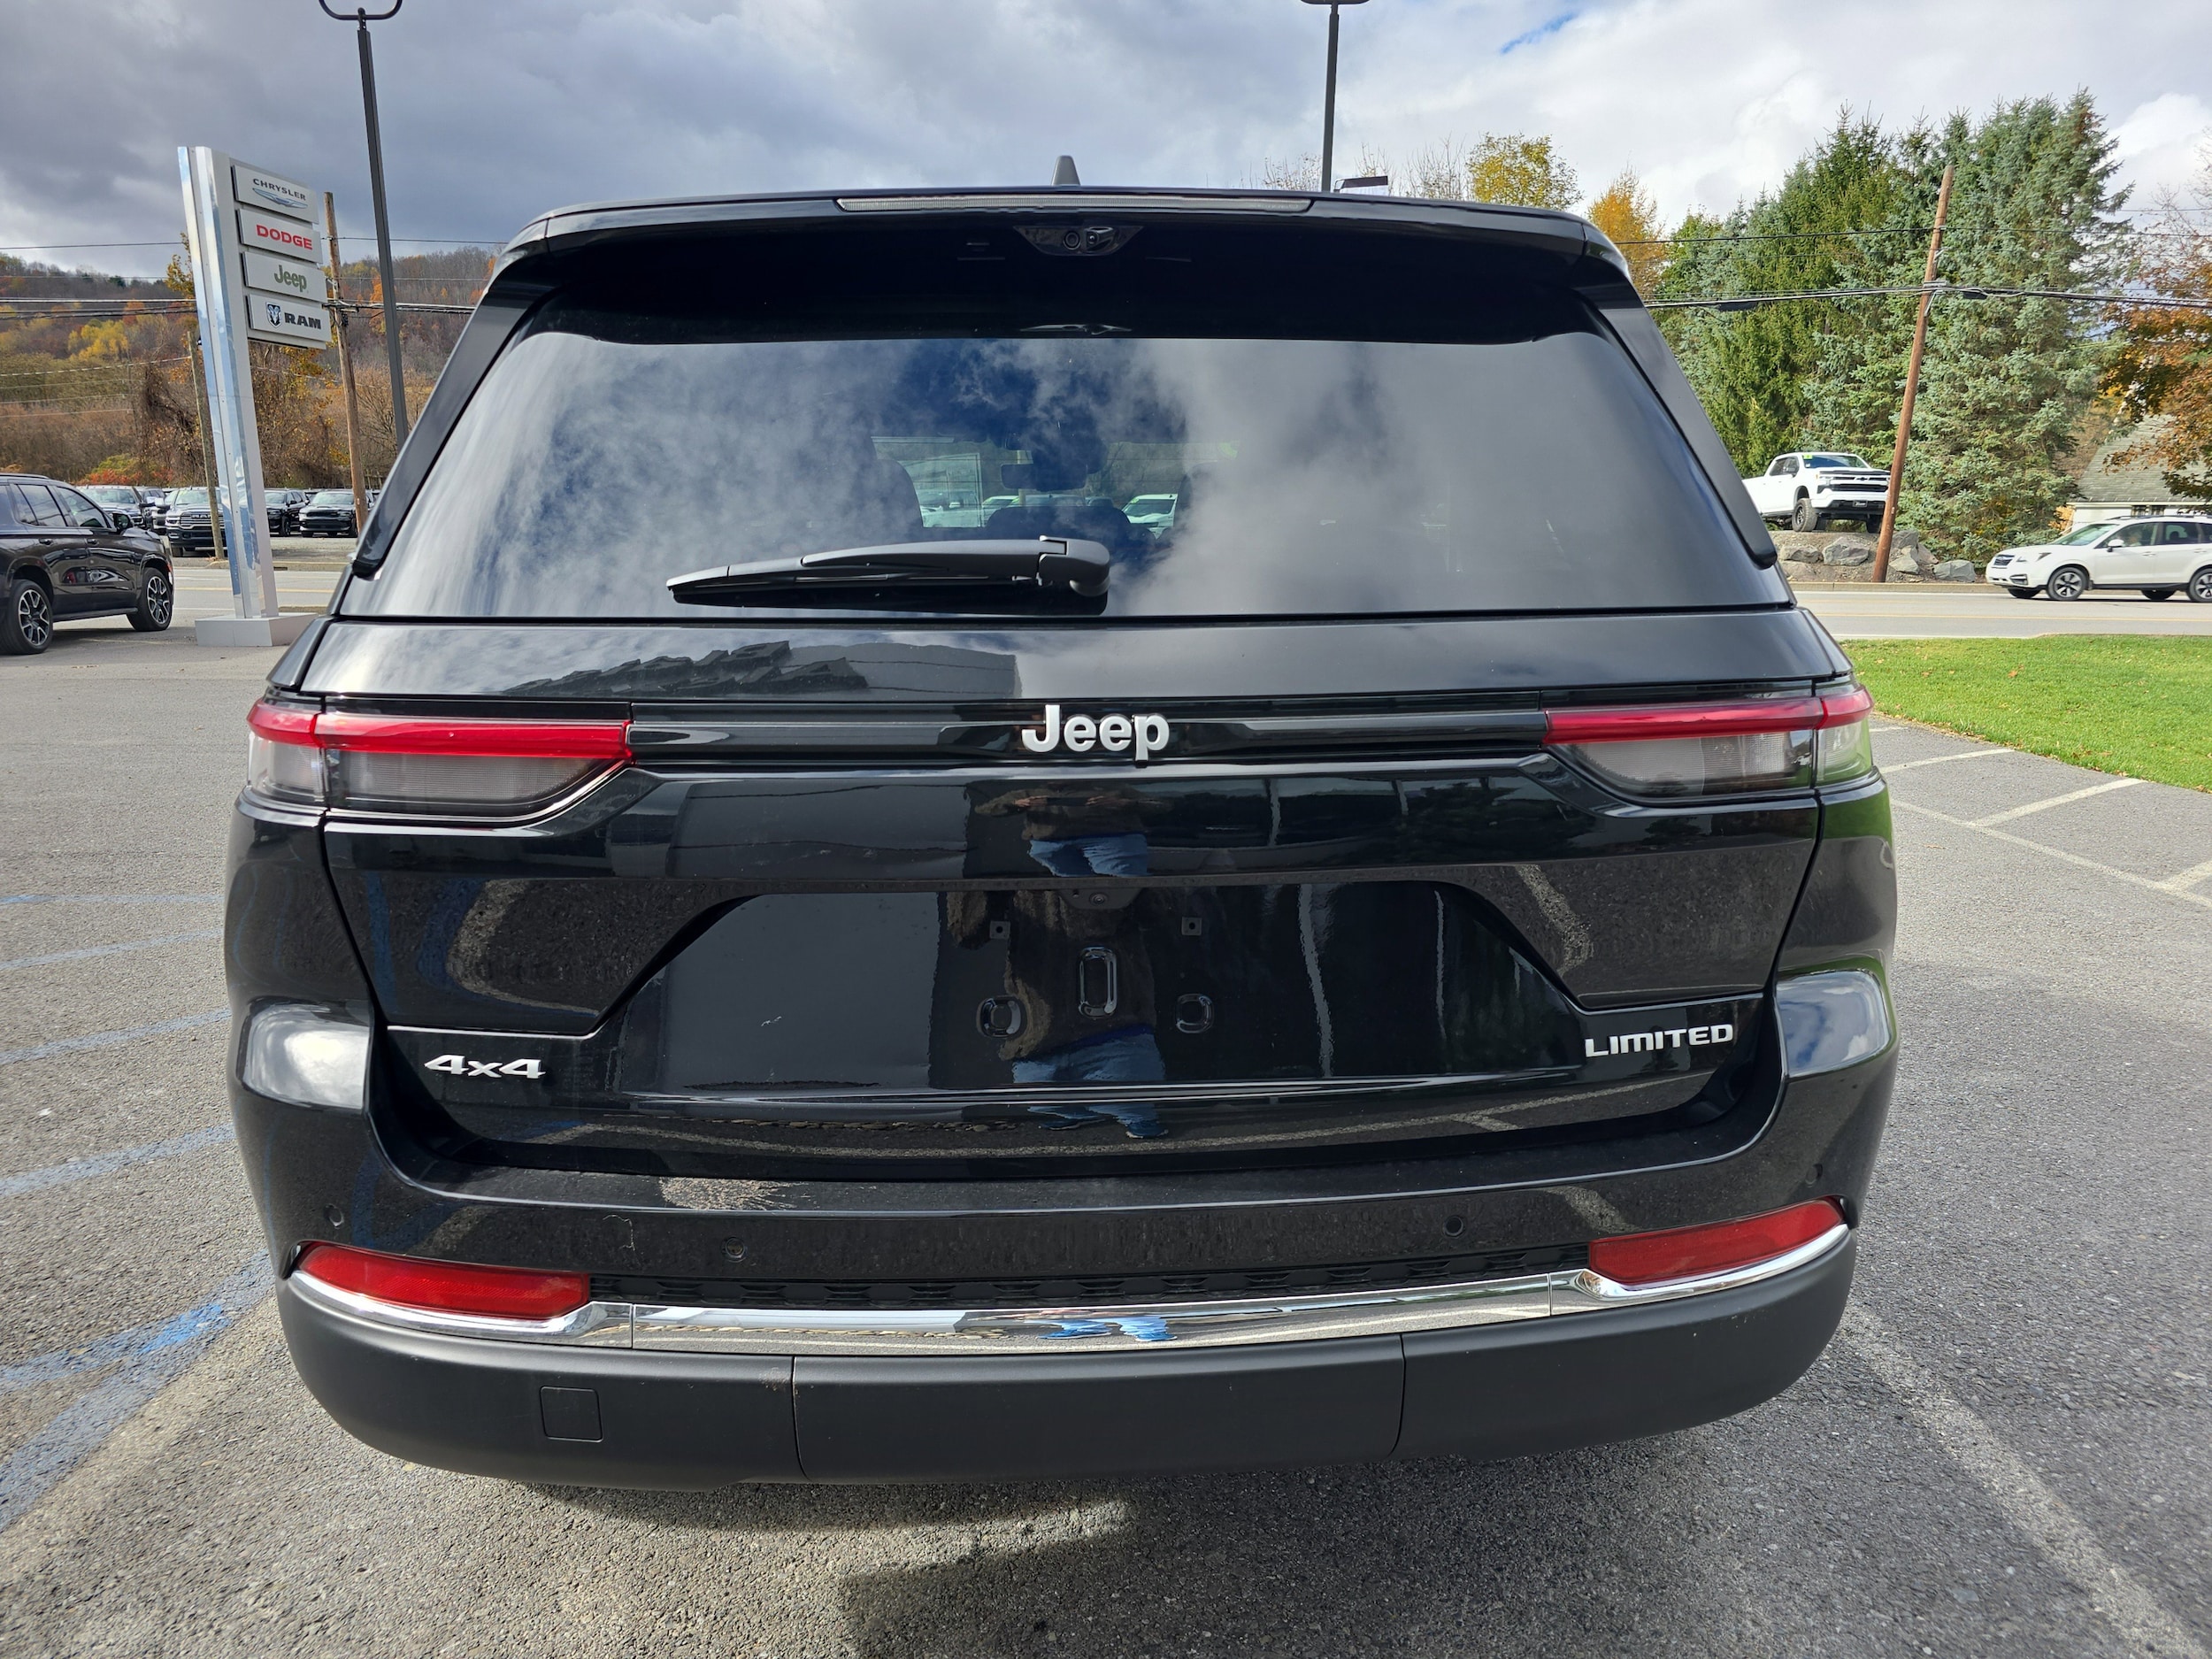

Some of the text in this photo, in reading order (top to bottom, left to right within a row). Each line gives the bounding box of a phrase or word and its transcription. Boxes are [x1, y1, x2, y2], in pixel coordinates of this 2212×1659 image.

[252, 178, 307, 201] CHRYSLER
[256, 224, 313, 250] DODGE
[273, 264, 308, 293] Jeep
[284, 312, 322, 330] RAM
[1021, 703, 1171, 763] Jeep
[1584, 1023, 1734, 1058] LIMITED
[423, 1054, 547, 1079] 4x4
